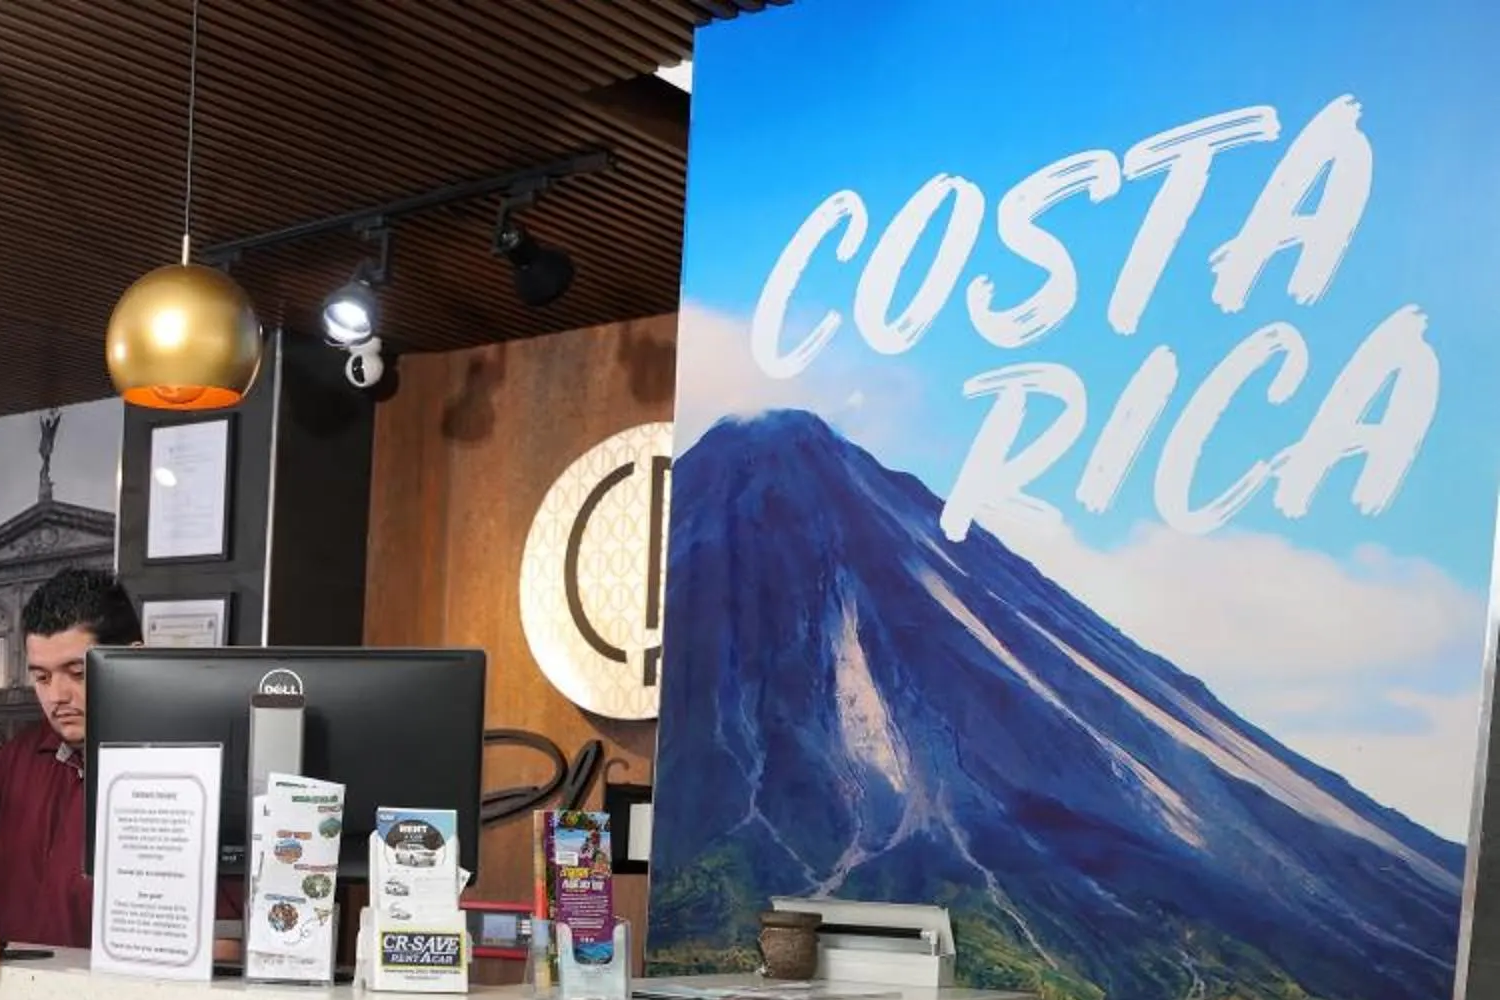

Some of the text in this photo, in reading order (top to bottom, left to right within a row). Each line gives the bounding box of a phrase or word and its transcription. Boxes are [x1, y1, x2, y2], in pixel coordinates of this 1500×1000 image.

[751, 93, 1373, 379] COSTA
[940, 303, 1440, 542] RICA
[265, 684, 298, 694] DELL
[383, 934, 459, 955] CR-SAVE
[391, 953, 419, 963] RENT
[431, 955, 454, 964] CAR
